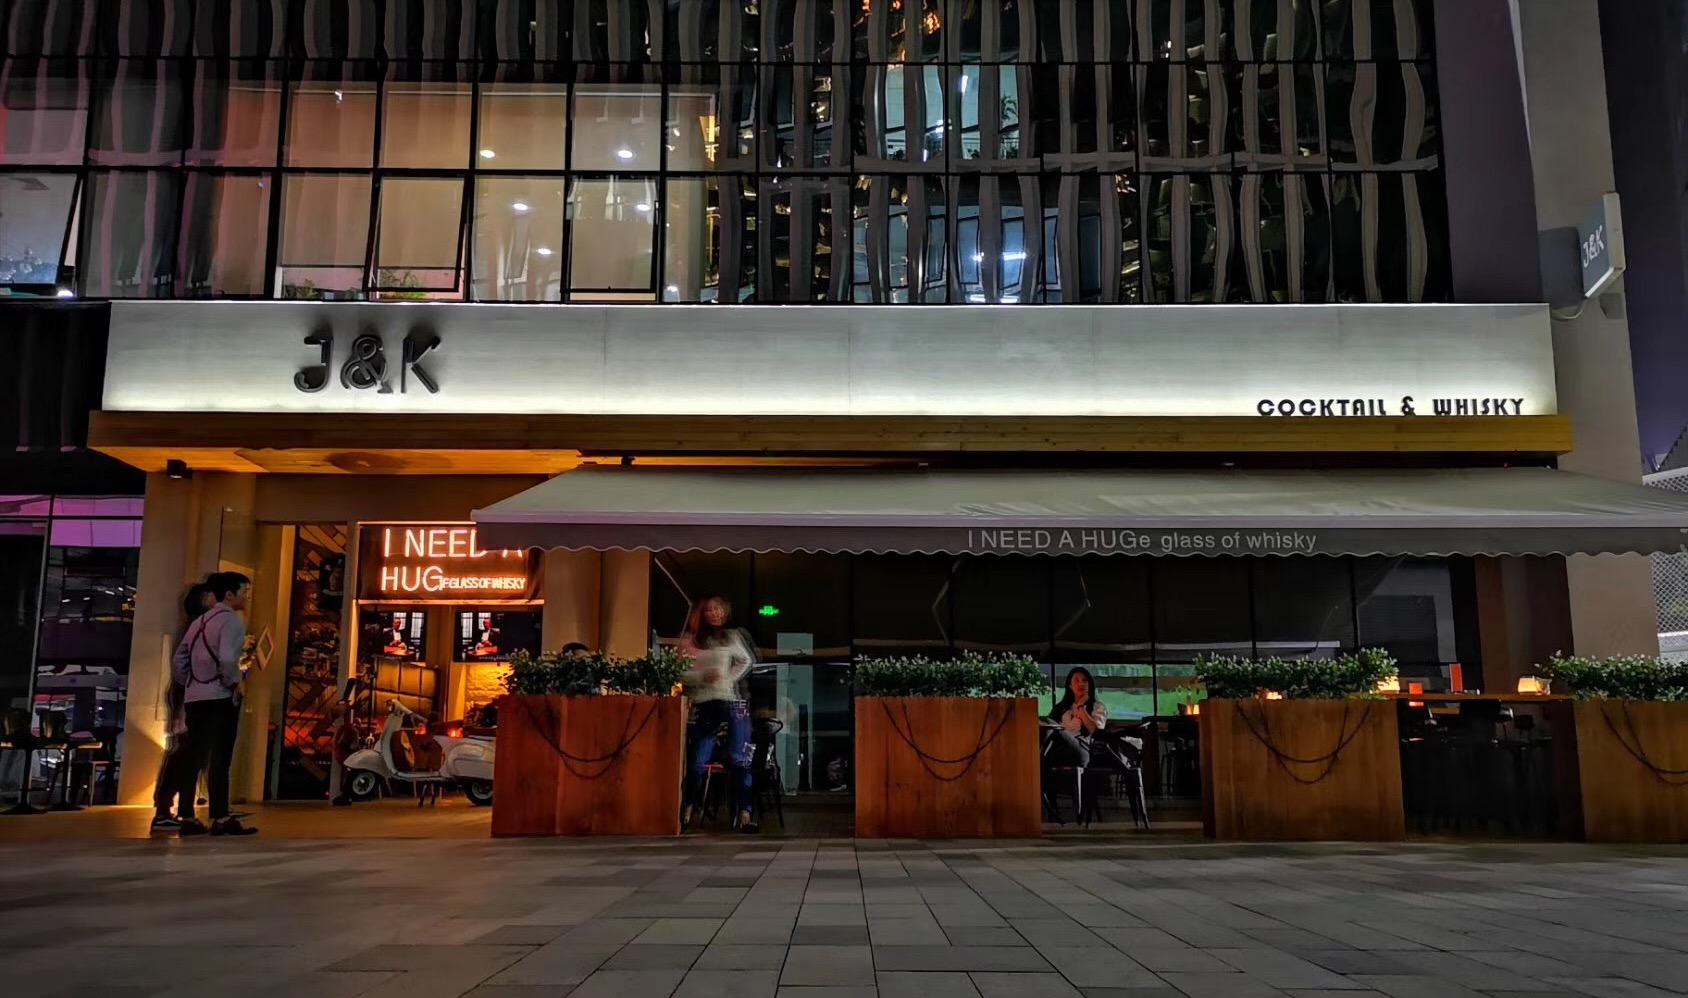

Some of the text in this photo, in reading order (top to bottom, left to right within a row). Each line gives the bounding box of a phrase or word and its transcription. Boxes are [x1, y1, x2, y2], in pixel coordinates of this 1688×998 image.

[1583, 225, 1605, 268] J&K
[294, 334, 440, 394] J&K
[1257, 395, 1525, 416] COCKTAIL & WHISKY
[383, 528, 391, 558] I
[968, 530, 973, 549] I
[981, 530, 1051, 549] NEED
[1058, 530, 1075, 549] A
[1160, 532, 1215, 552] glass
[1221, 532, 1240, 549] of
[1245, 532, 1317, 553] whisky
